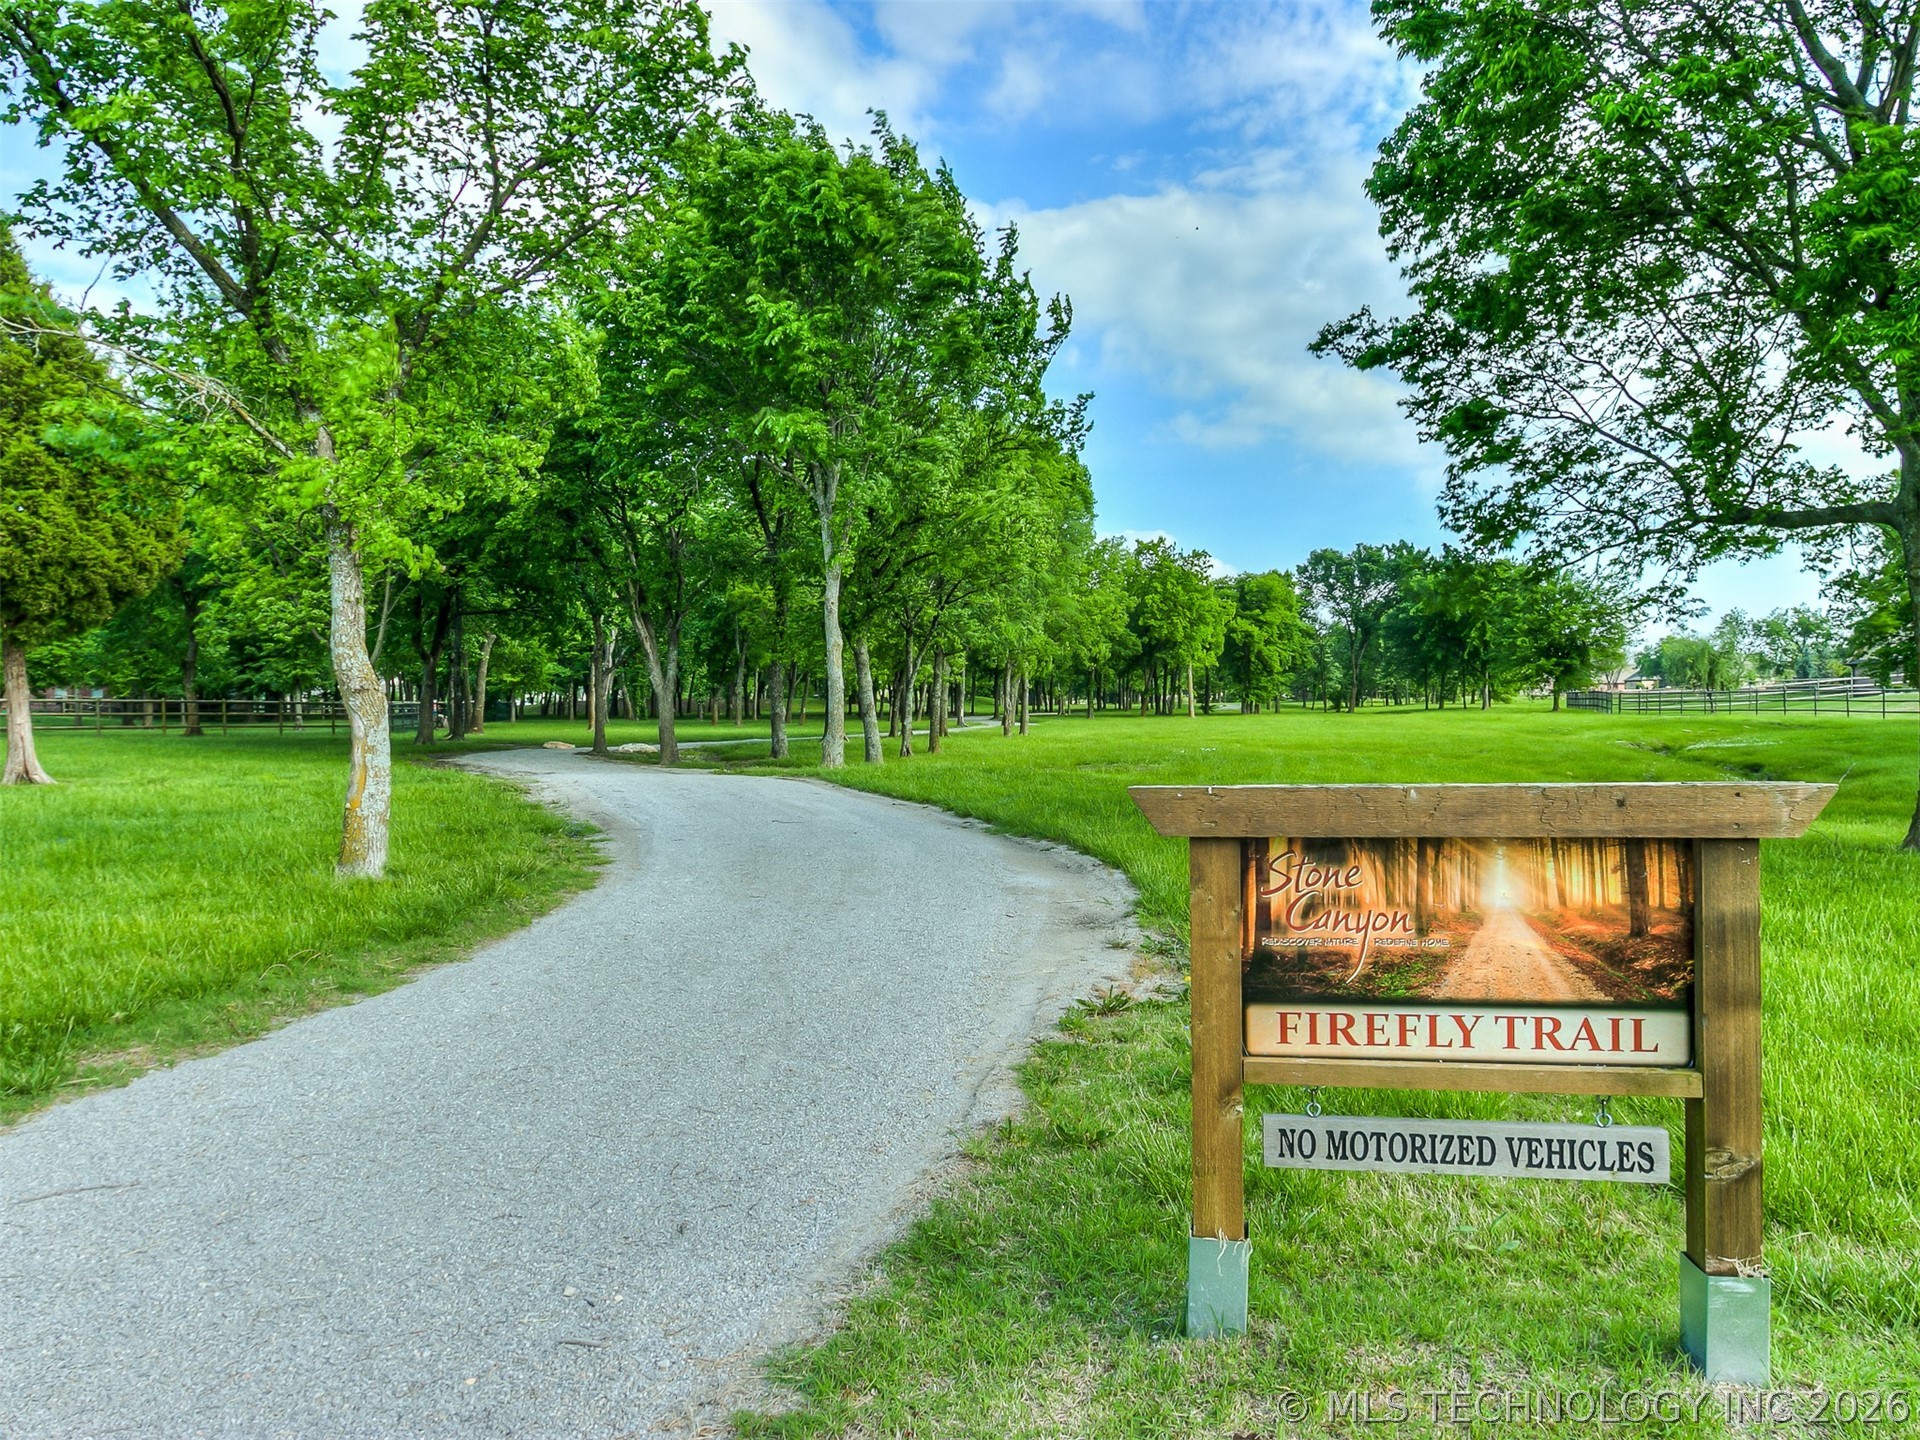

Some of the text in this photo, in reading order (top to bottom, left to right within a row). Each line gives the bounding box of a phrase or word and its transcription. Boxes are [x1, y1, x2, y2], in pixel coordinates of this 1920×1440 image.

[1260, 850, 1363, 898] Stone
[1285, 891, 1415, 985] Canyon
[1276, 1011, 1659, 1053] FIREFLY TRAIL
[1278, 1128, 1656, 1174] NO MOTORIZED VEHICLES
